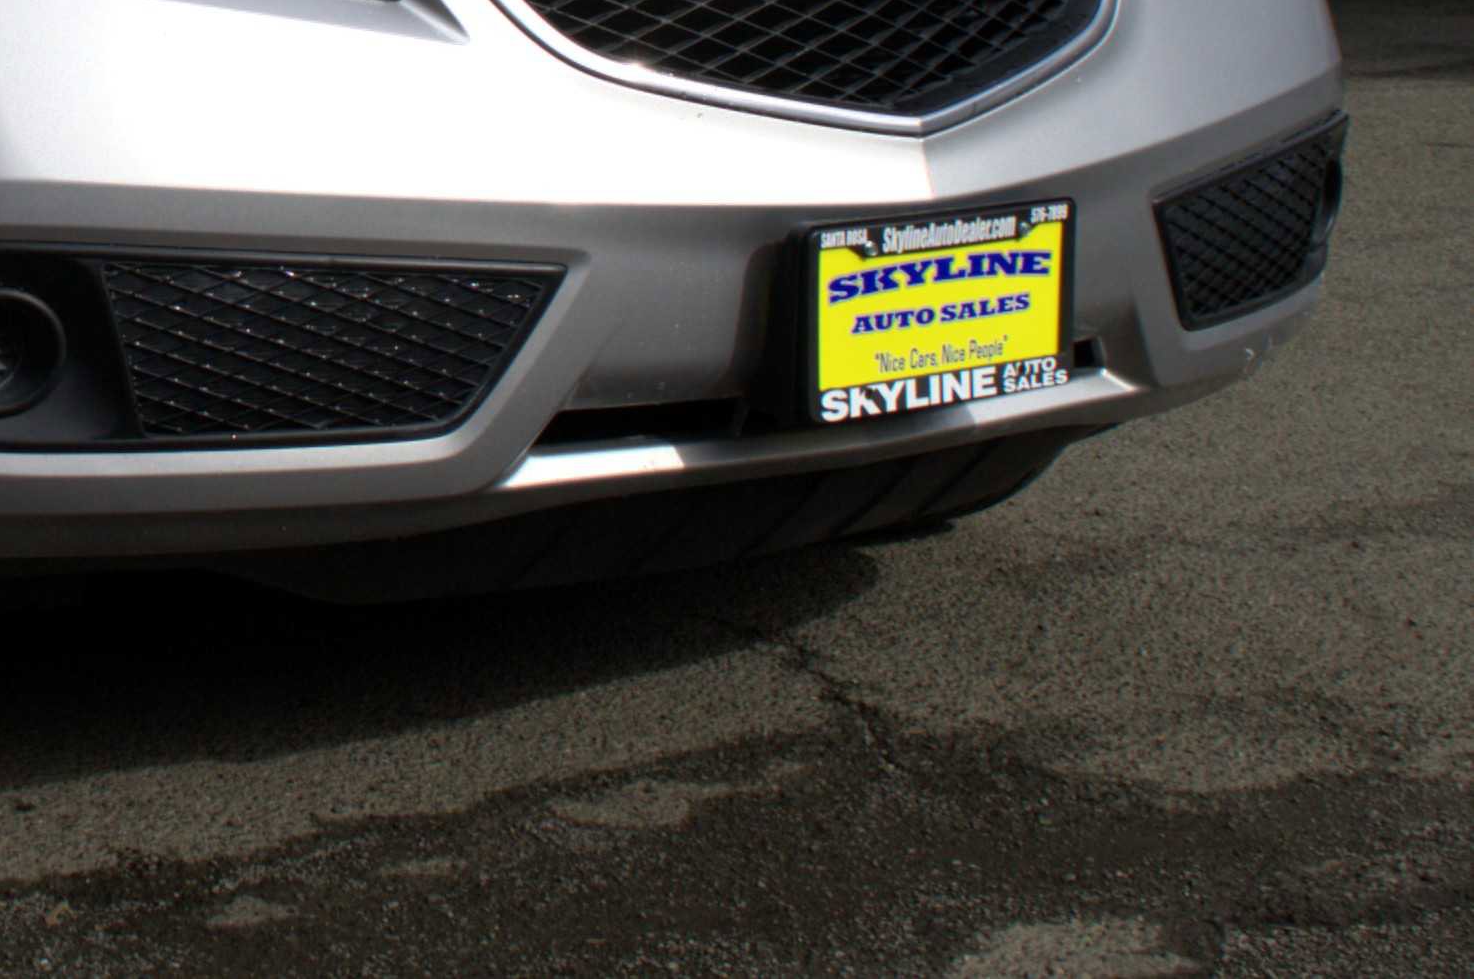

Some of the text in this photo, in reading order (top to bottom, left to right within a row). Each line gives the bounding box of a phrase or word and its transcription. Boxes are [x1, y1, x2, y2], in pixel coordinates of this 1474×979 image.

[882, 216, 1016, 253] SkylineAutoDealer.com
[827, 250, 1052, 304] SKYLINE
[851, 293, 1030, 334] AUTO SALES
[874, 351, 905, 373] "Nice
[942, 344, 965, 364] Nice
[969, 334, 1009, 362] People"
[1003, 356, 1057, 378] AUTO
[820, 366, 997, 422] SKYLINE
[1003, 369, 1068, 393] SALES
